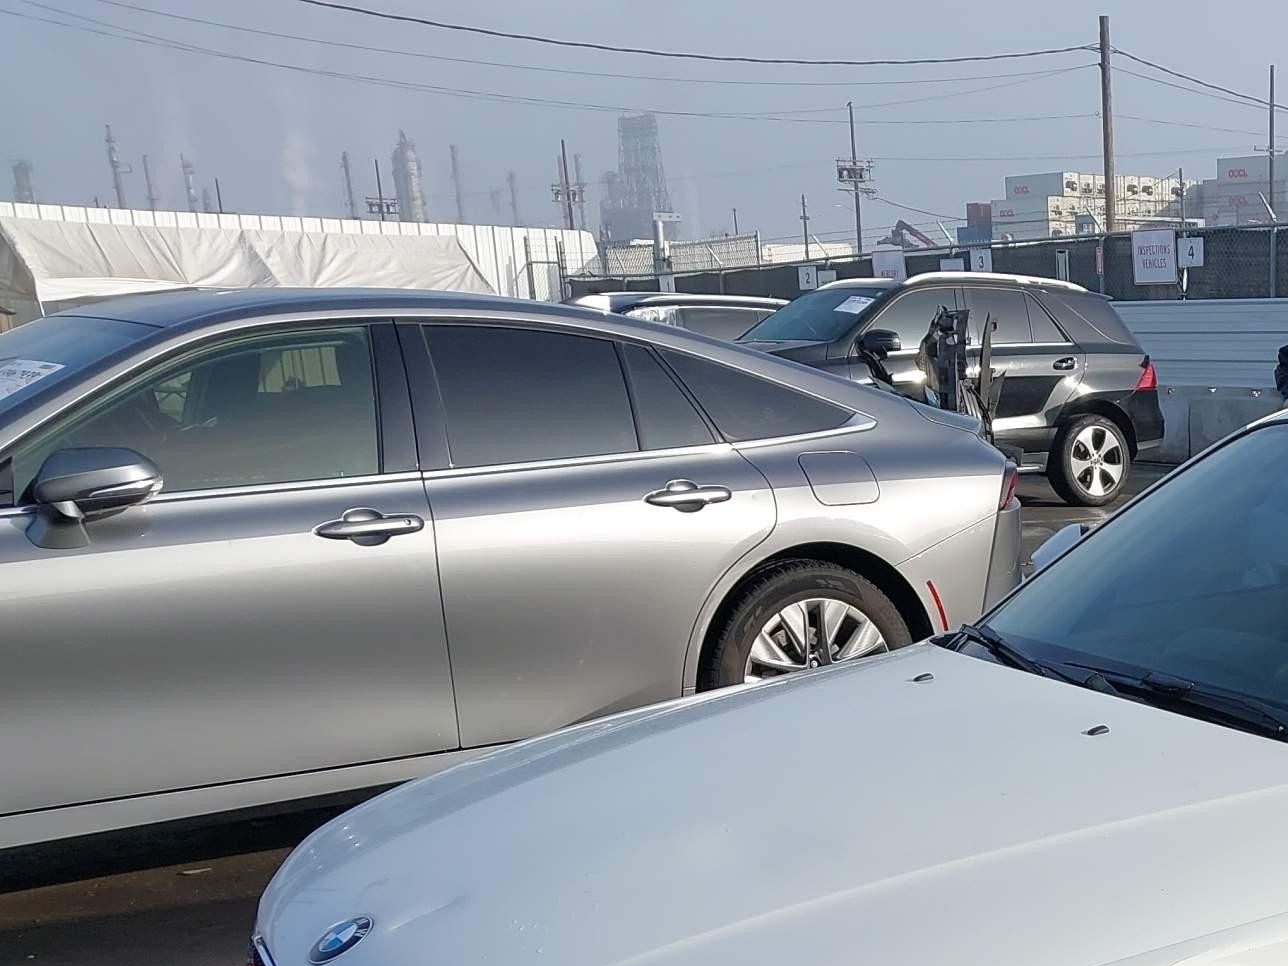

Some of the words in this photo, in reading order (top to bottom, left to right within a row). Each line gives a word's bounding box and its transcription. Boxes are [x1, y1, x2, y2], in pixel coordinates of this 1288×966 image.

[1187, 245, 1195, 260] 4
[978, 255, 985, 269] 3
[805, 272, 811, 284] 2
